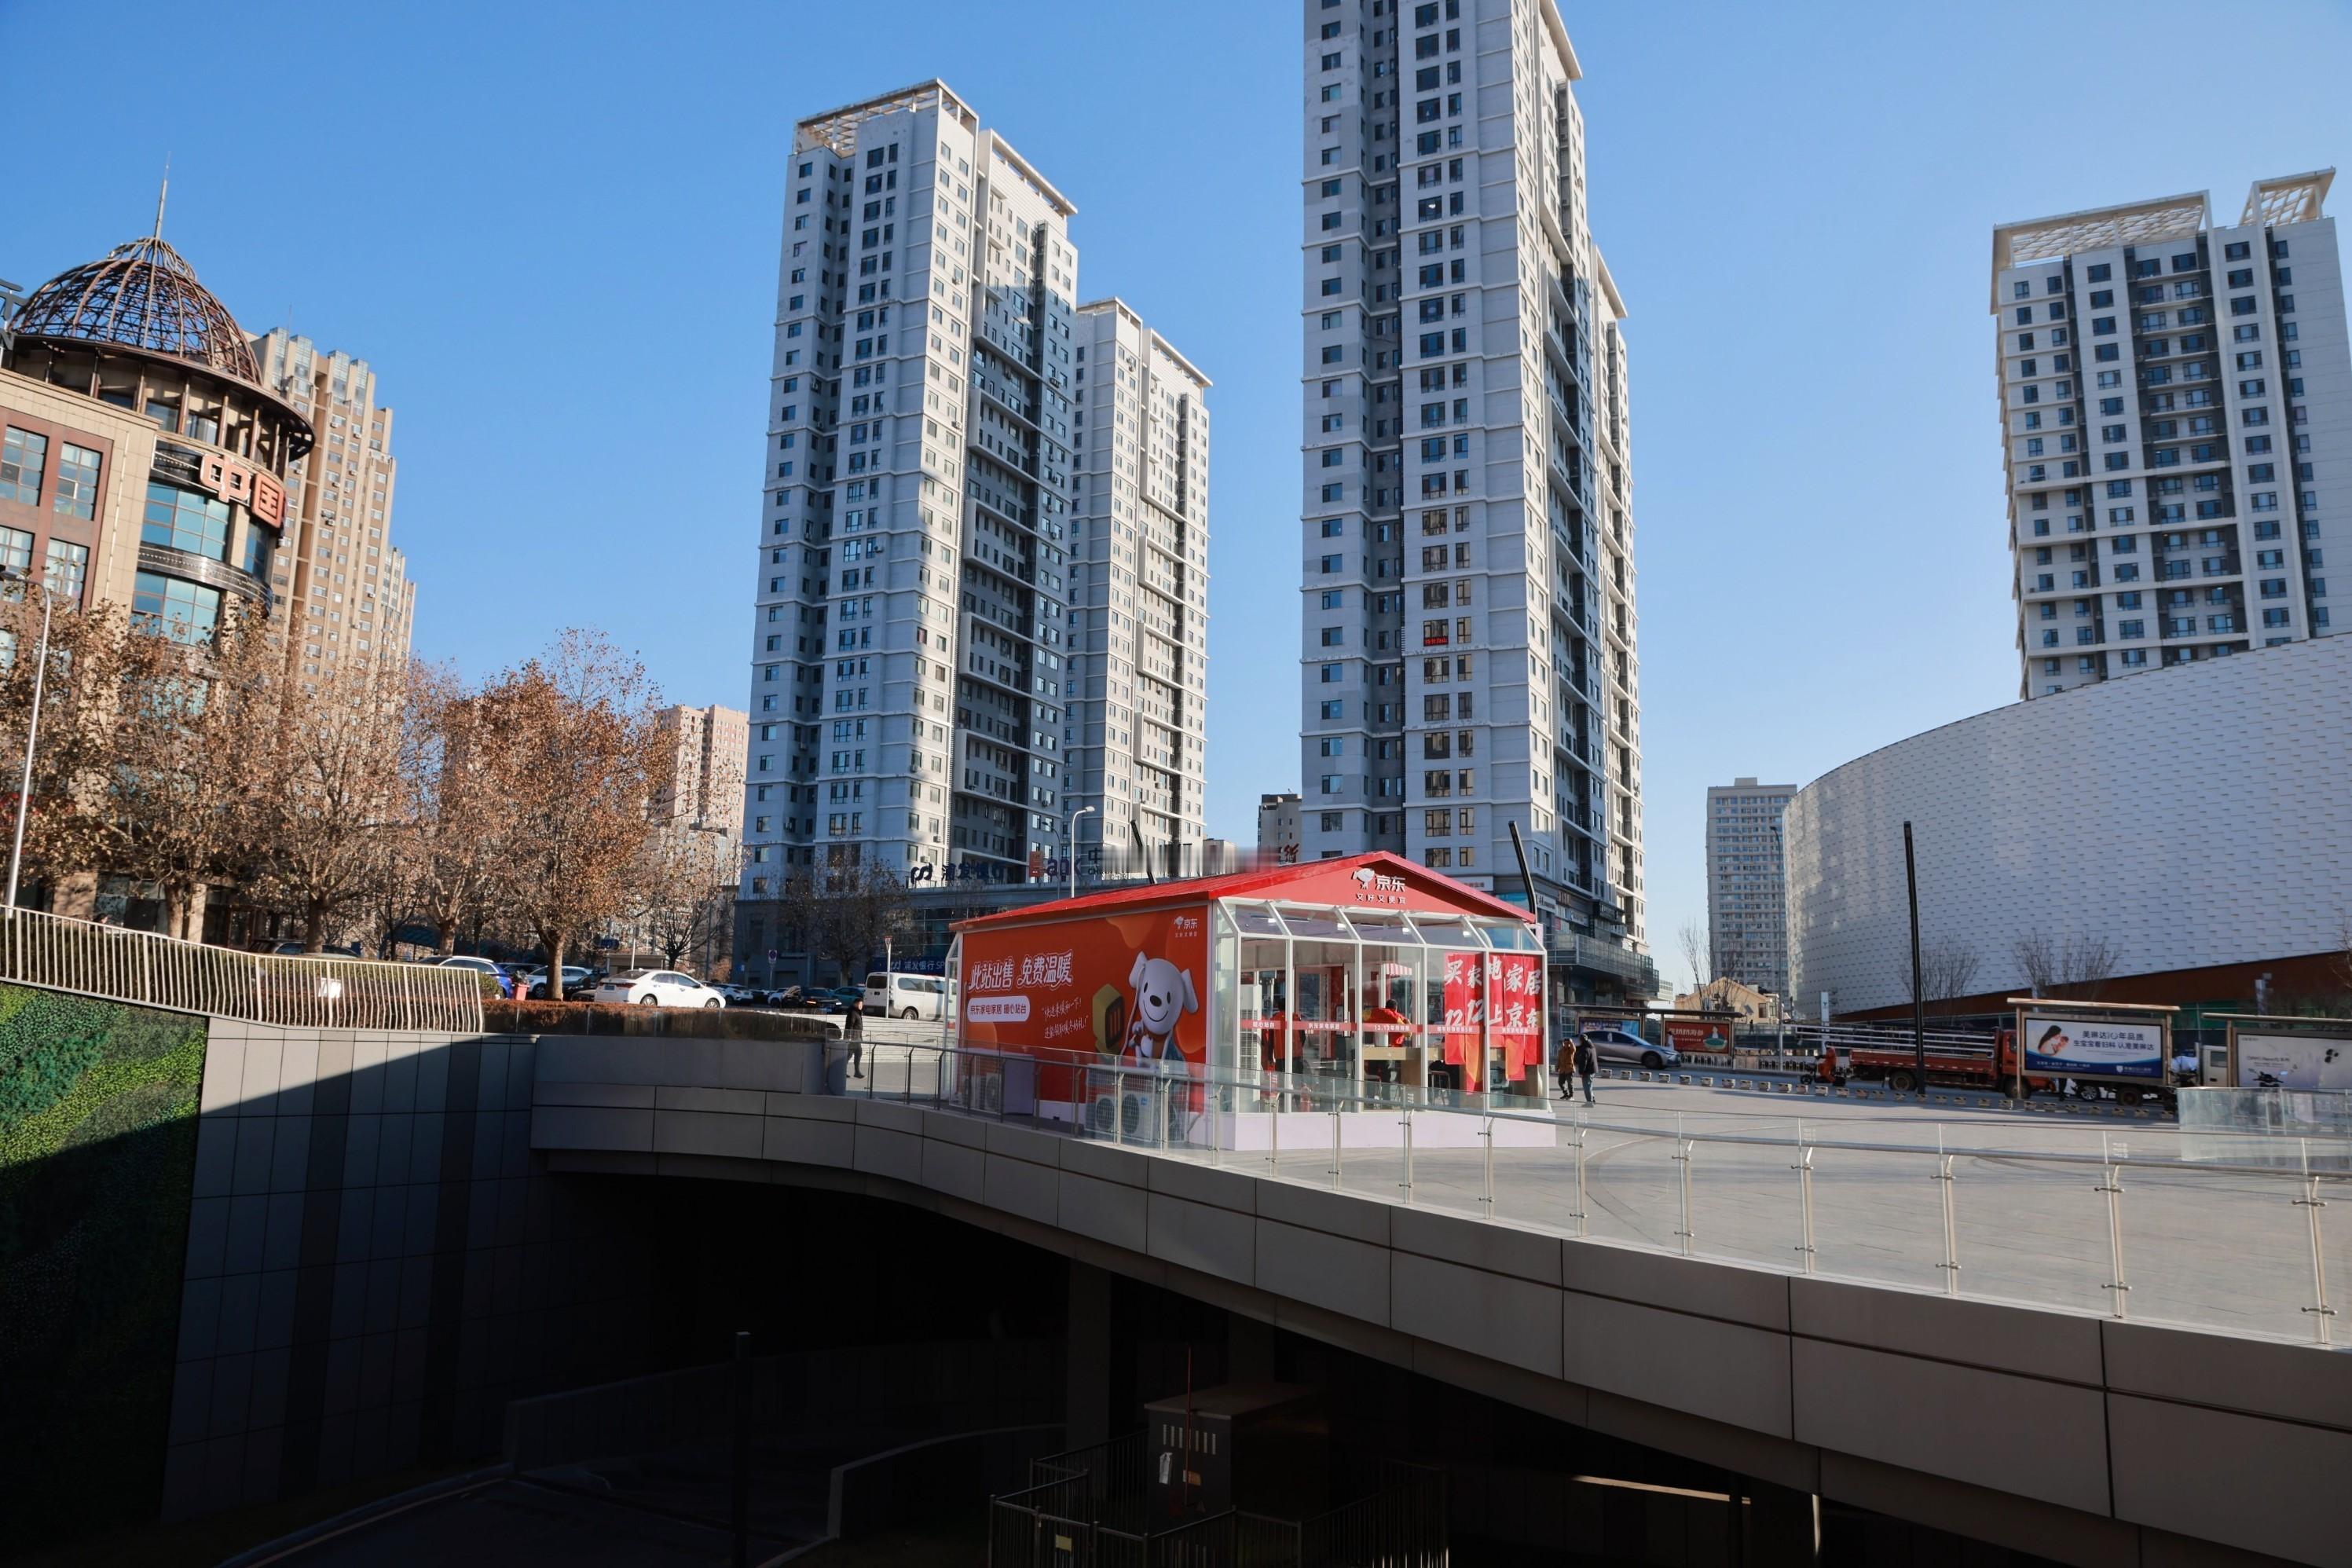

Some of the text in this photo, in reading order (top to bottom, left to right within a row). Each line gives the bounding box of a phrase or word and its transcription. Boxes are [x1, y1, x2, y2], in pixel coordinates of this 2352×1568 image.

[1376, 875, 1405, 892] 京东
[1357, 893, 1405, 904] 又好又便宜
[1184, 918, 1198, 929] 京东
[904, 961, 935, 970] 浦发银行
[968, 950, 1072, 991] 此站出售 免费温暖
[970, 1004, 1026, 1015] 京东家电家居 暖心站台
